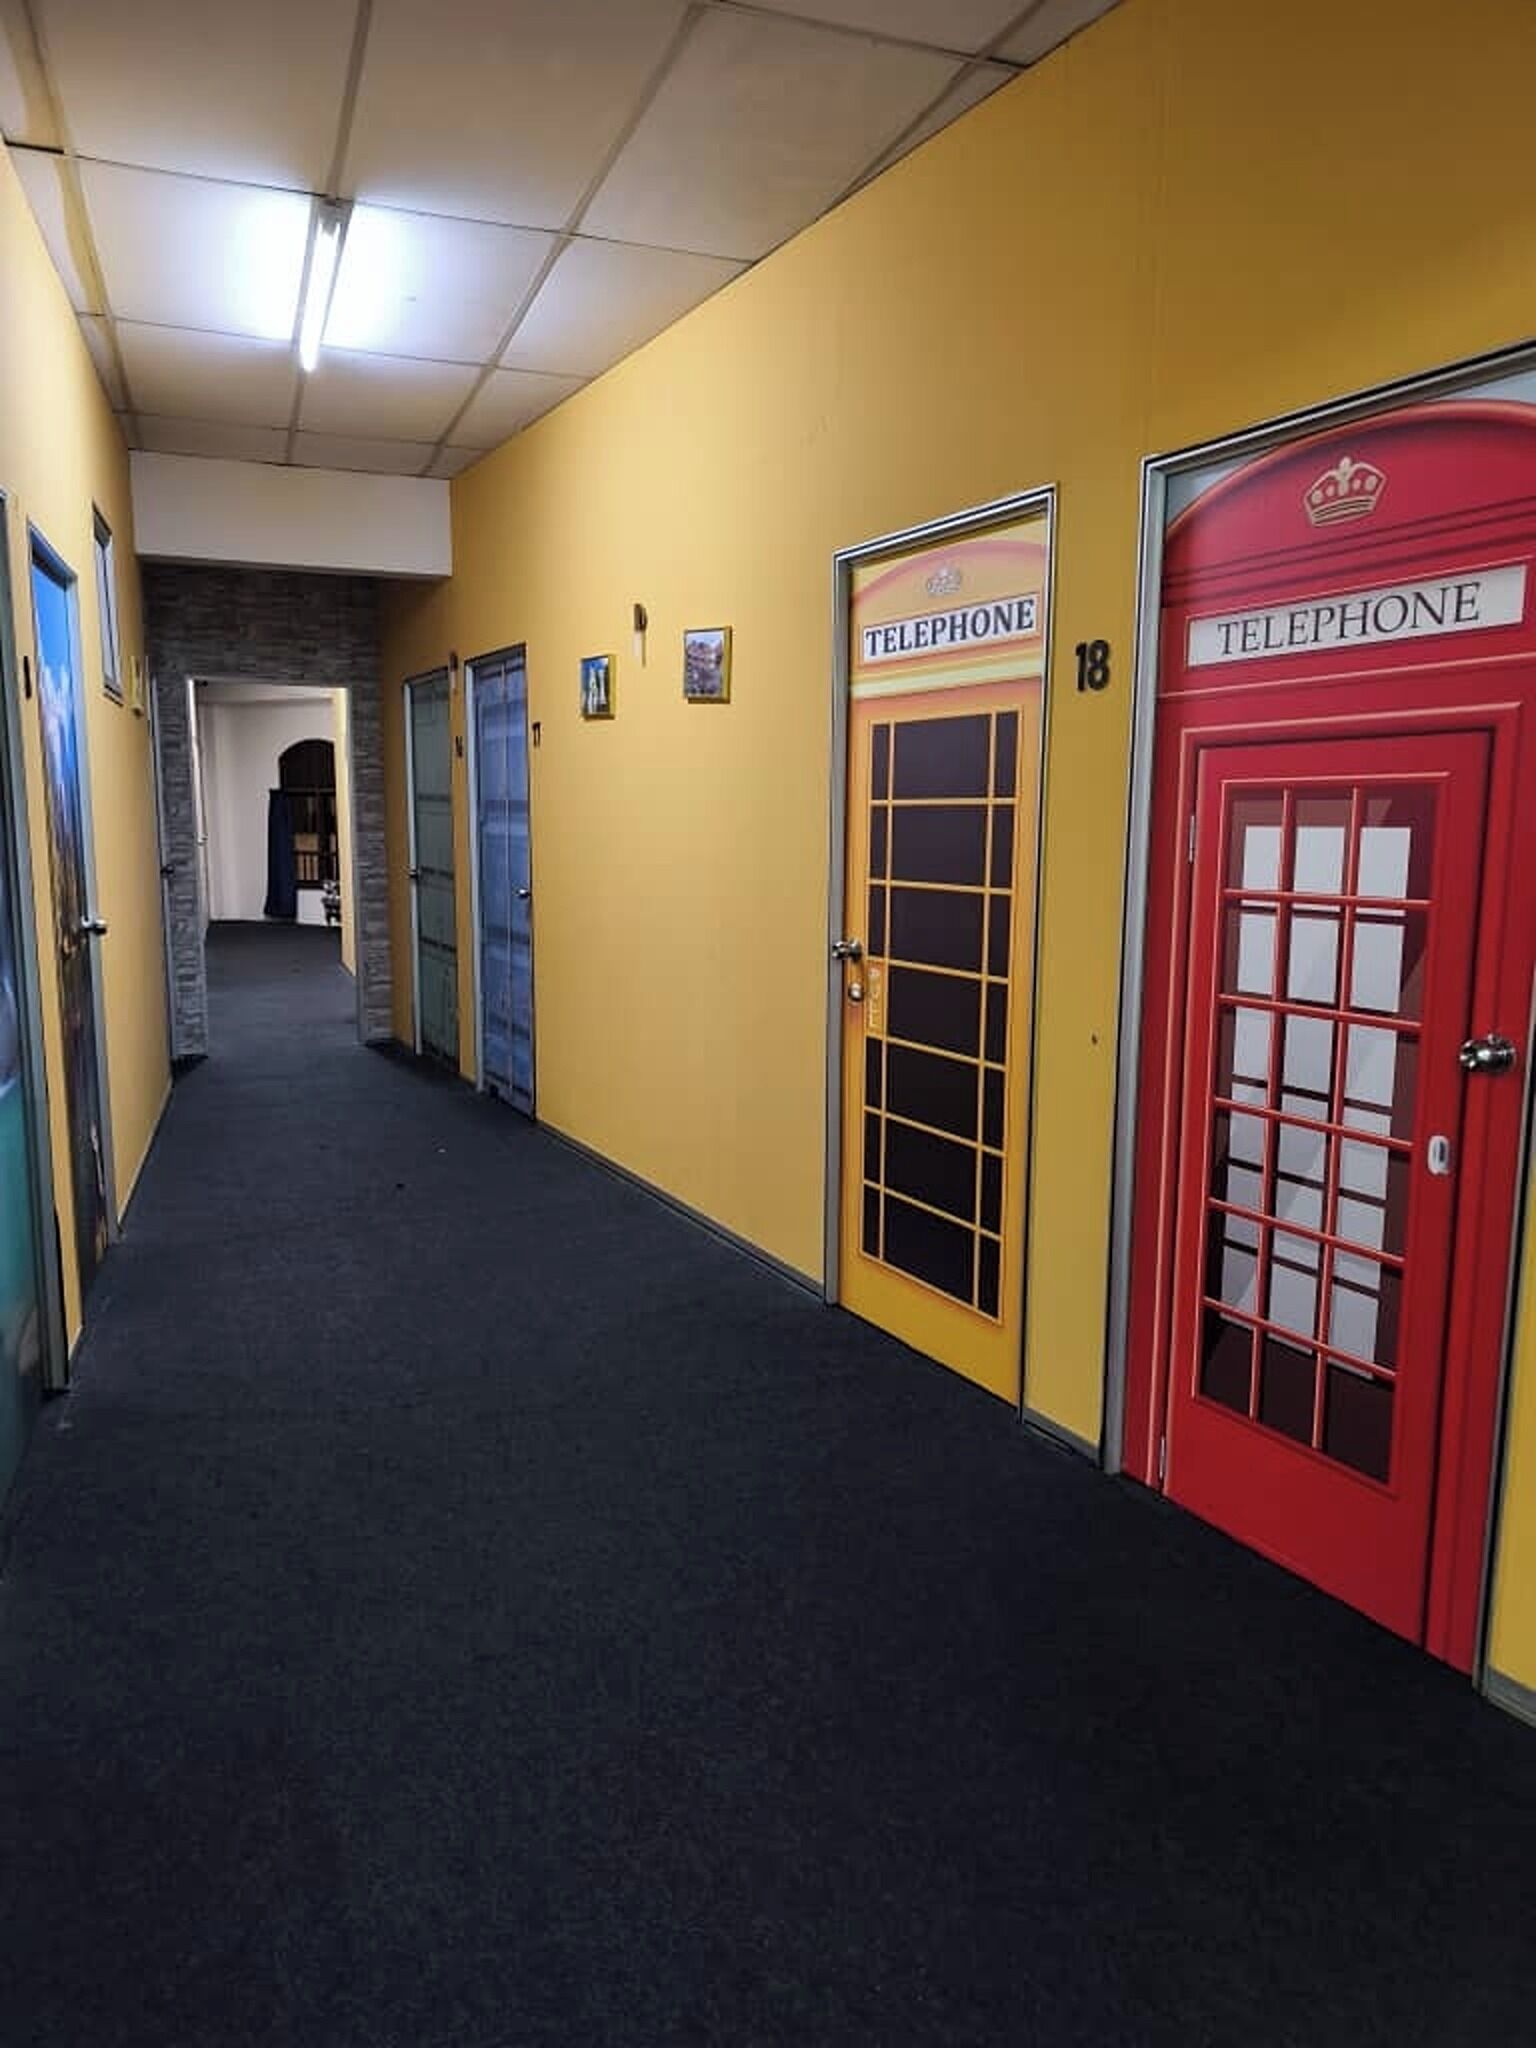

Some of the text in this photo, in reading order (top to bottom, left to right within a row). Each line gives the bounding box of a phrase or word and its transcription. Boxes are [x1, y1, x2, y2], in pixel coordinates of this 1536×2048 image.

[866, 599, 1034, 656] TELEPHONE
[1218, 582, 1480, 655] TELEPHONE
[1075, 639, 1110, 691] 18
